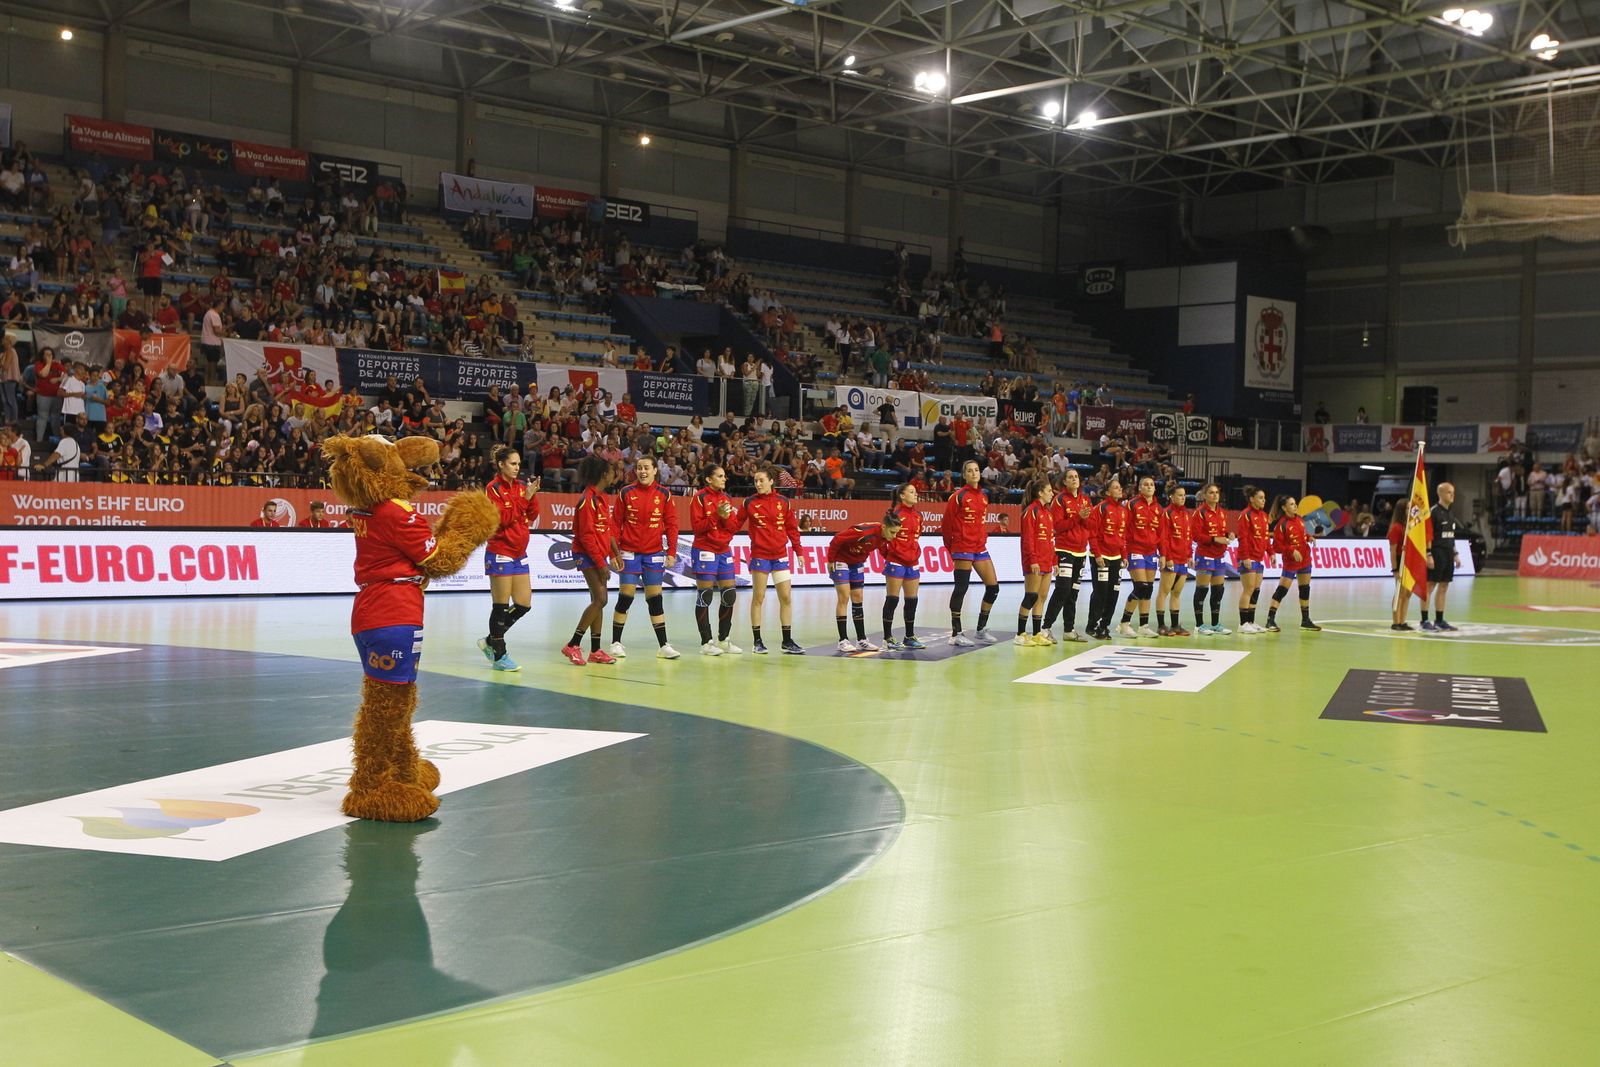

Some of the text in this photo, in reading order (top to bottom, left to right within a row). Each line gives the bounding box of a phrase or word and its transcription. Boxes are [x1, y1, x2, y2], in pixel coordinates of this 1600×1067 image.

[71, 125, 83, 134] La
[83, 127, 101, 138] Voz
[102, 129, 113, 140] de
[235, 149, 246, 158] La
[247, 151, 262, 161] Voz
[262, 153, 273, 163] de
[605, 202, 643, 222] SER
[358, 359, 420, 372] DEPORTES
[359, 369, 374, 378] DE
[458, 366, 518, 379] DEPORTES
[458, 376, 473, 386] DE
[643, 380, 693, 392] DEPORTES
[643, 390, 693, 401] DE ALMERIA
[940, 403, 996, 418] CLAUSE
[11, 494, 185, 513] Women's EHF EURO
[13, 514, 147, 527] 2020 Qualifiers
[819, 509, 848, 520] EURO
